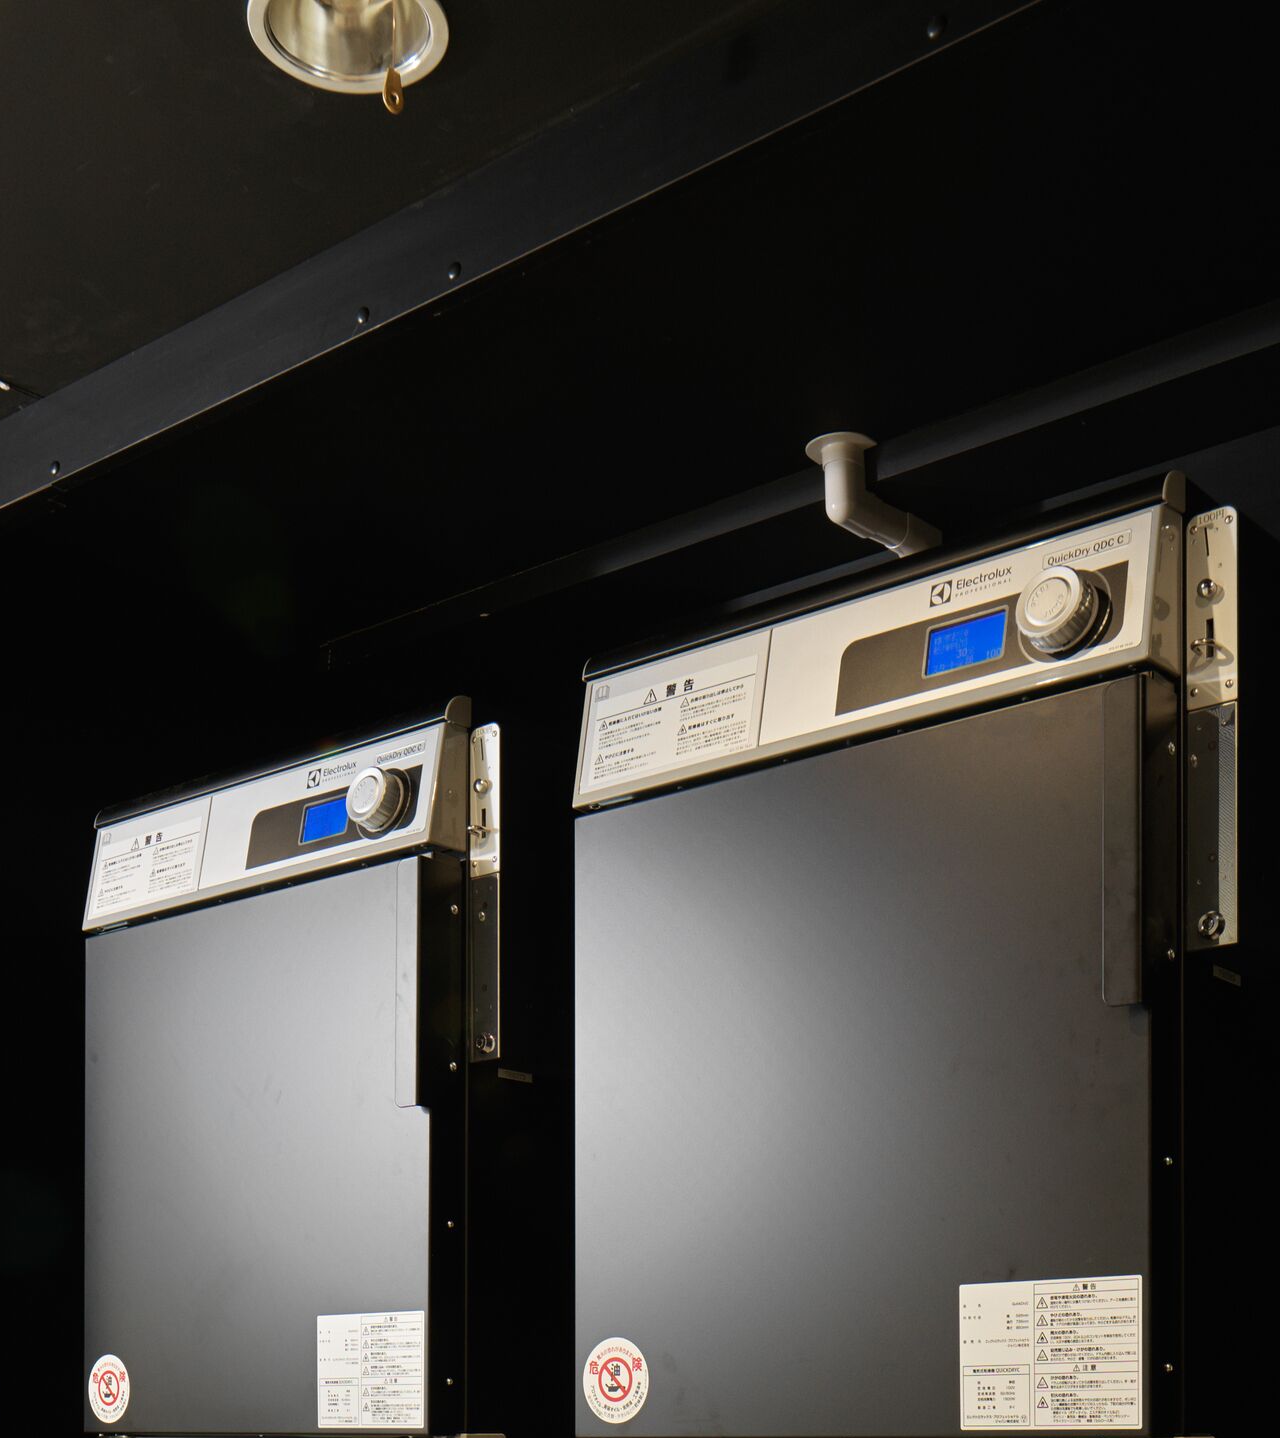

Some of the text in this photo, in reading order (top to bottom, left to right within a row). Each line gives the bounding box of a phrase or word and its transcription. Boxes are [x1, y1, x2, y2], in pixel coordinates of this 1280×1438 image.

[1047, 547, 1091, 566] QuickDry
[1093, 538, 1115, 553] QDC
[956, 566, 1012, 590] Electrolux
[323, 761, 357, 777] Electrolux
